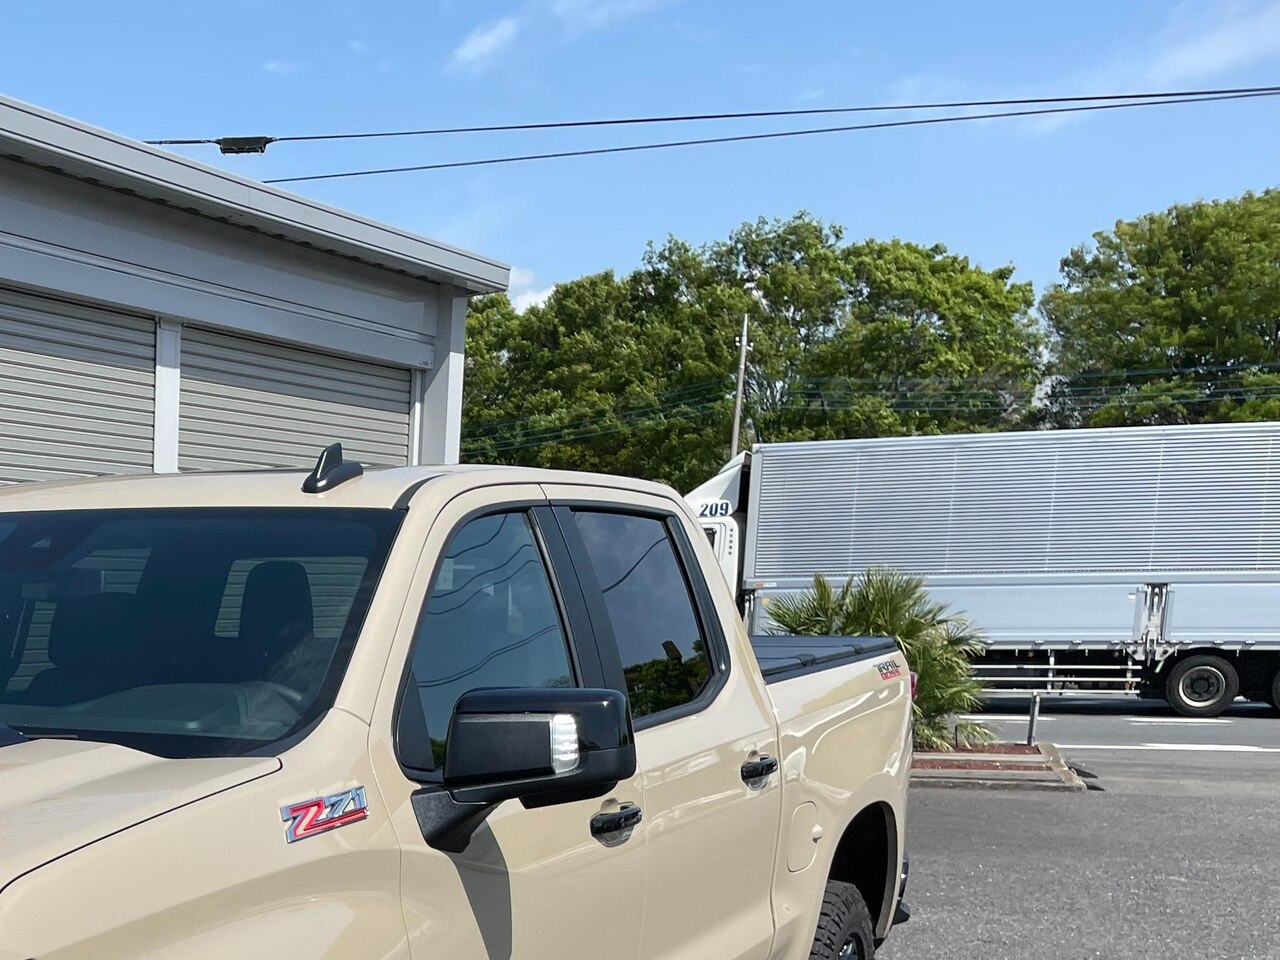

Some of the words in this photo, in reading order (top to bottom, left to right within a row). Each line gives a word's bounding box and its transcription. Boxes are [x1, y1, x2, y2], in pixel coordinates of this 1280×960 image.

[700, 502, 730, 517] 209
[872, 660, 901, 673] TRAIL
[279, 784, 370, 844] Z71
